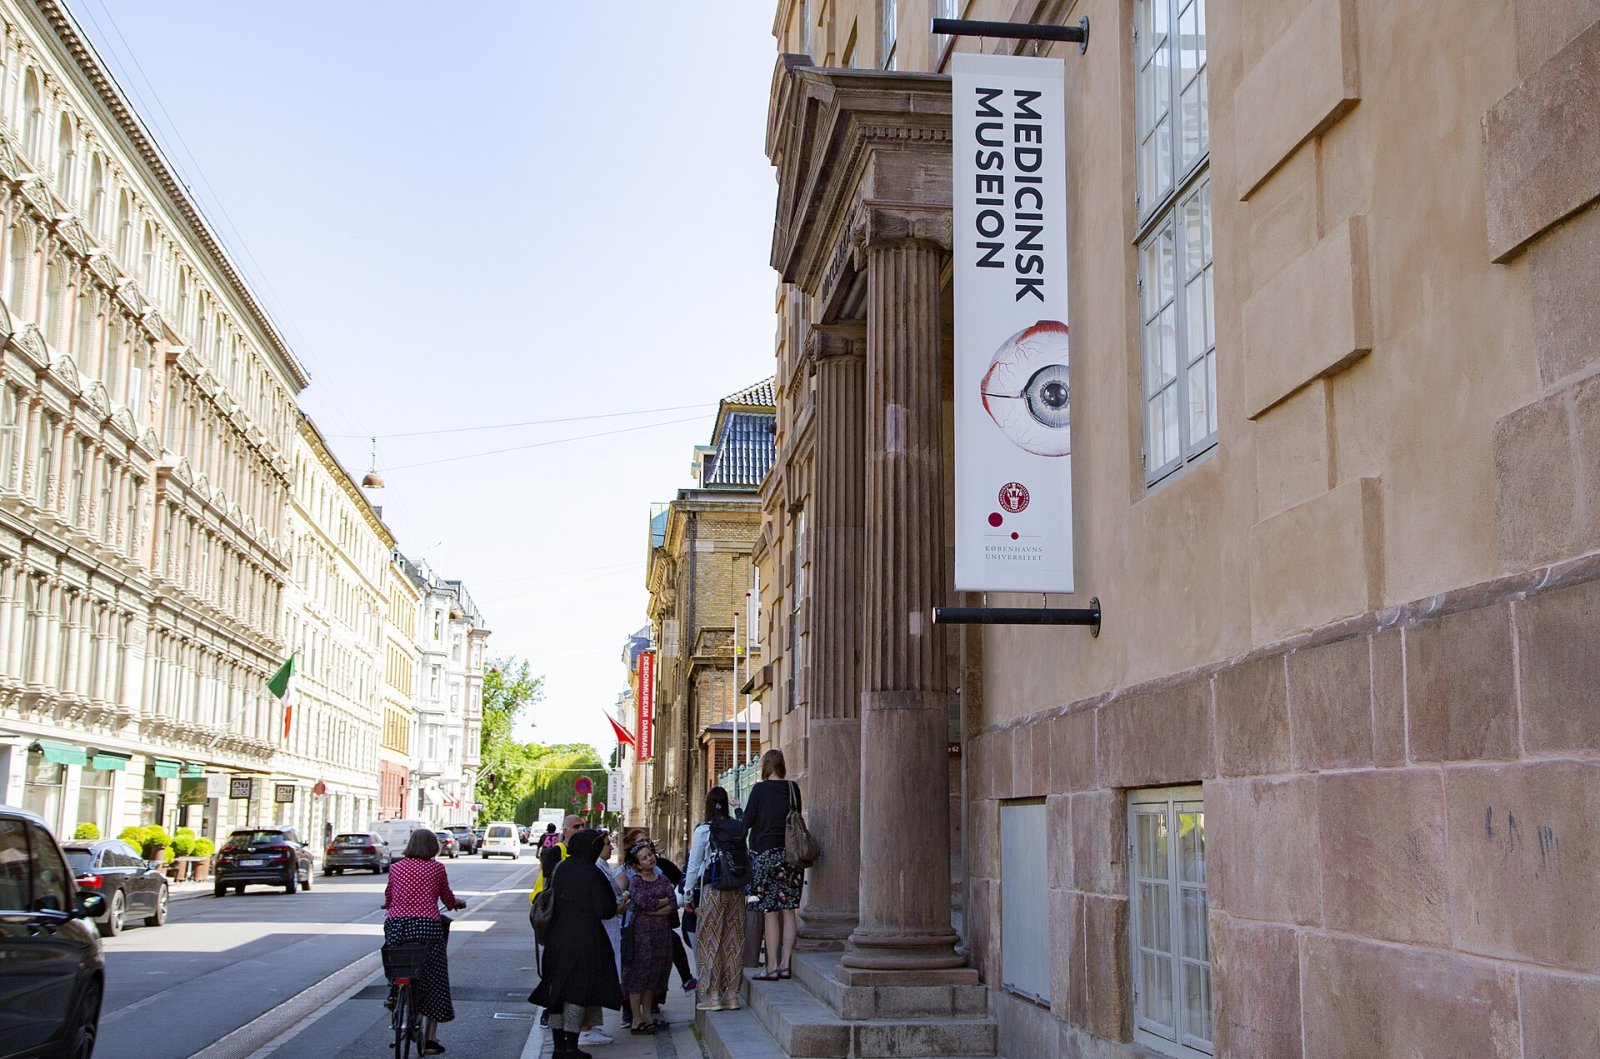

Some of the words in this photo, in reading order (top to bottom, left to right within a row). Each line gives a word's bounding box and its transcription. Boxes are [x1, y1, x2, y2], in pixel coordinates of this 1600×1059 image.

[975, 87, 1005, 268] MUSEION
[1013, 89, 1045, 303] MEDICINSK
[985, 545, 1043, 553] KØBENHAVNS
[642, 656, 650, 717] DESIGNMUSEUM
